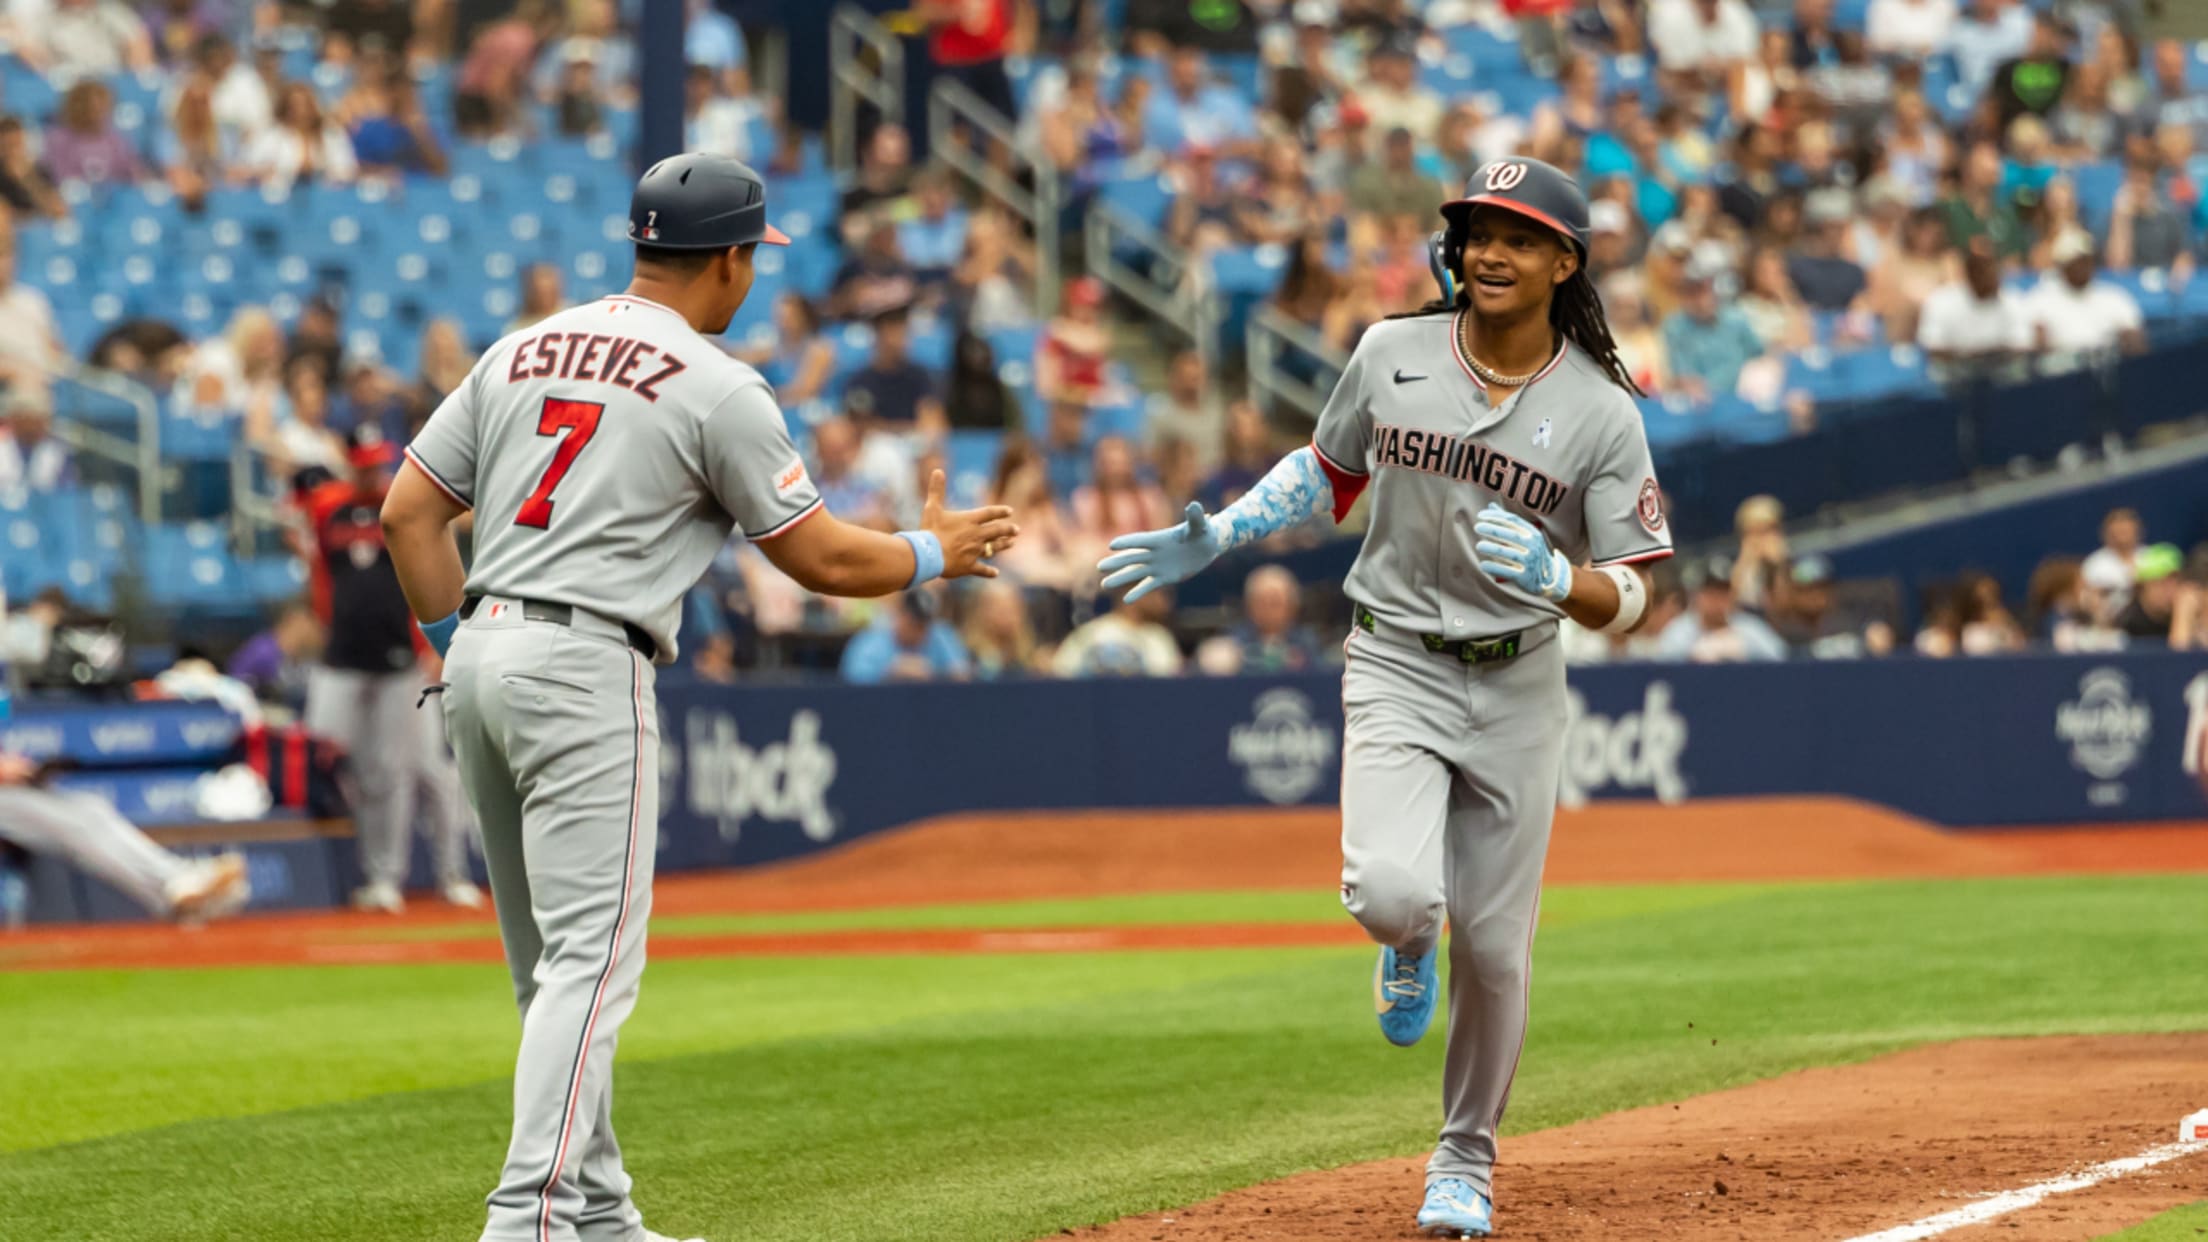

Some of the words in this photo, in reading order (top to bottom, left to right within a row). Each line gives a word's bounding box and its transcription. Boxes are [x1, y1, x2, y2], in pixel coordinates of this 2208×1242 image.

[1486, 161, 1528, 191] W
[648, 210, 658, 227] 7
[508, 332, 687, 404] ESTEVEZ
[513, 396, 606, 531] 7
